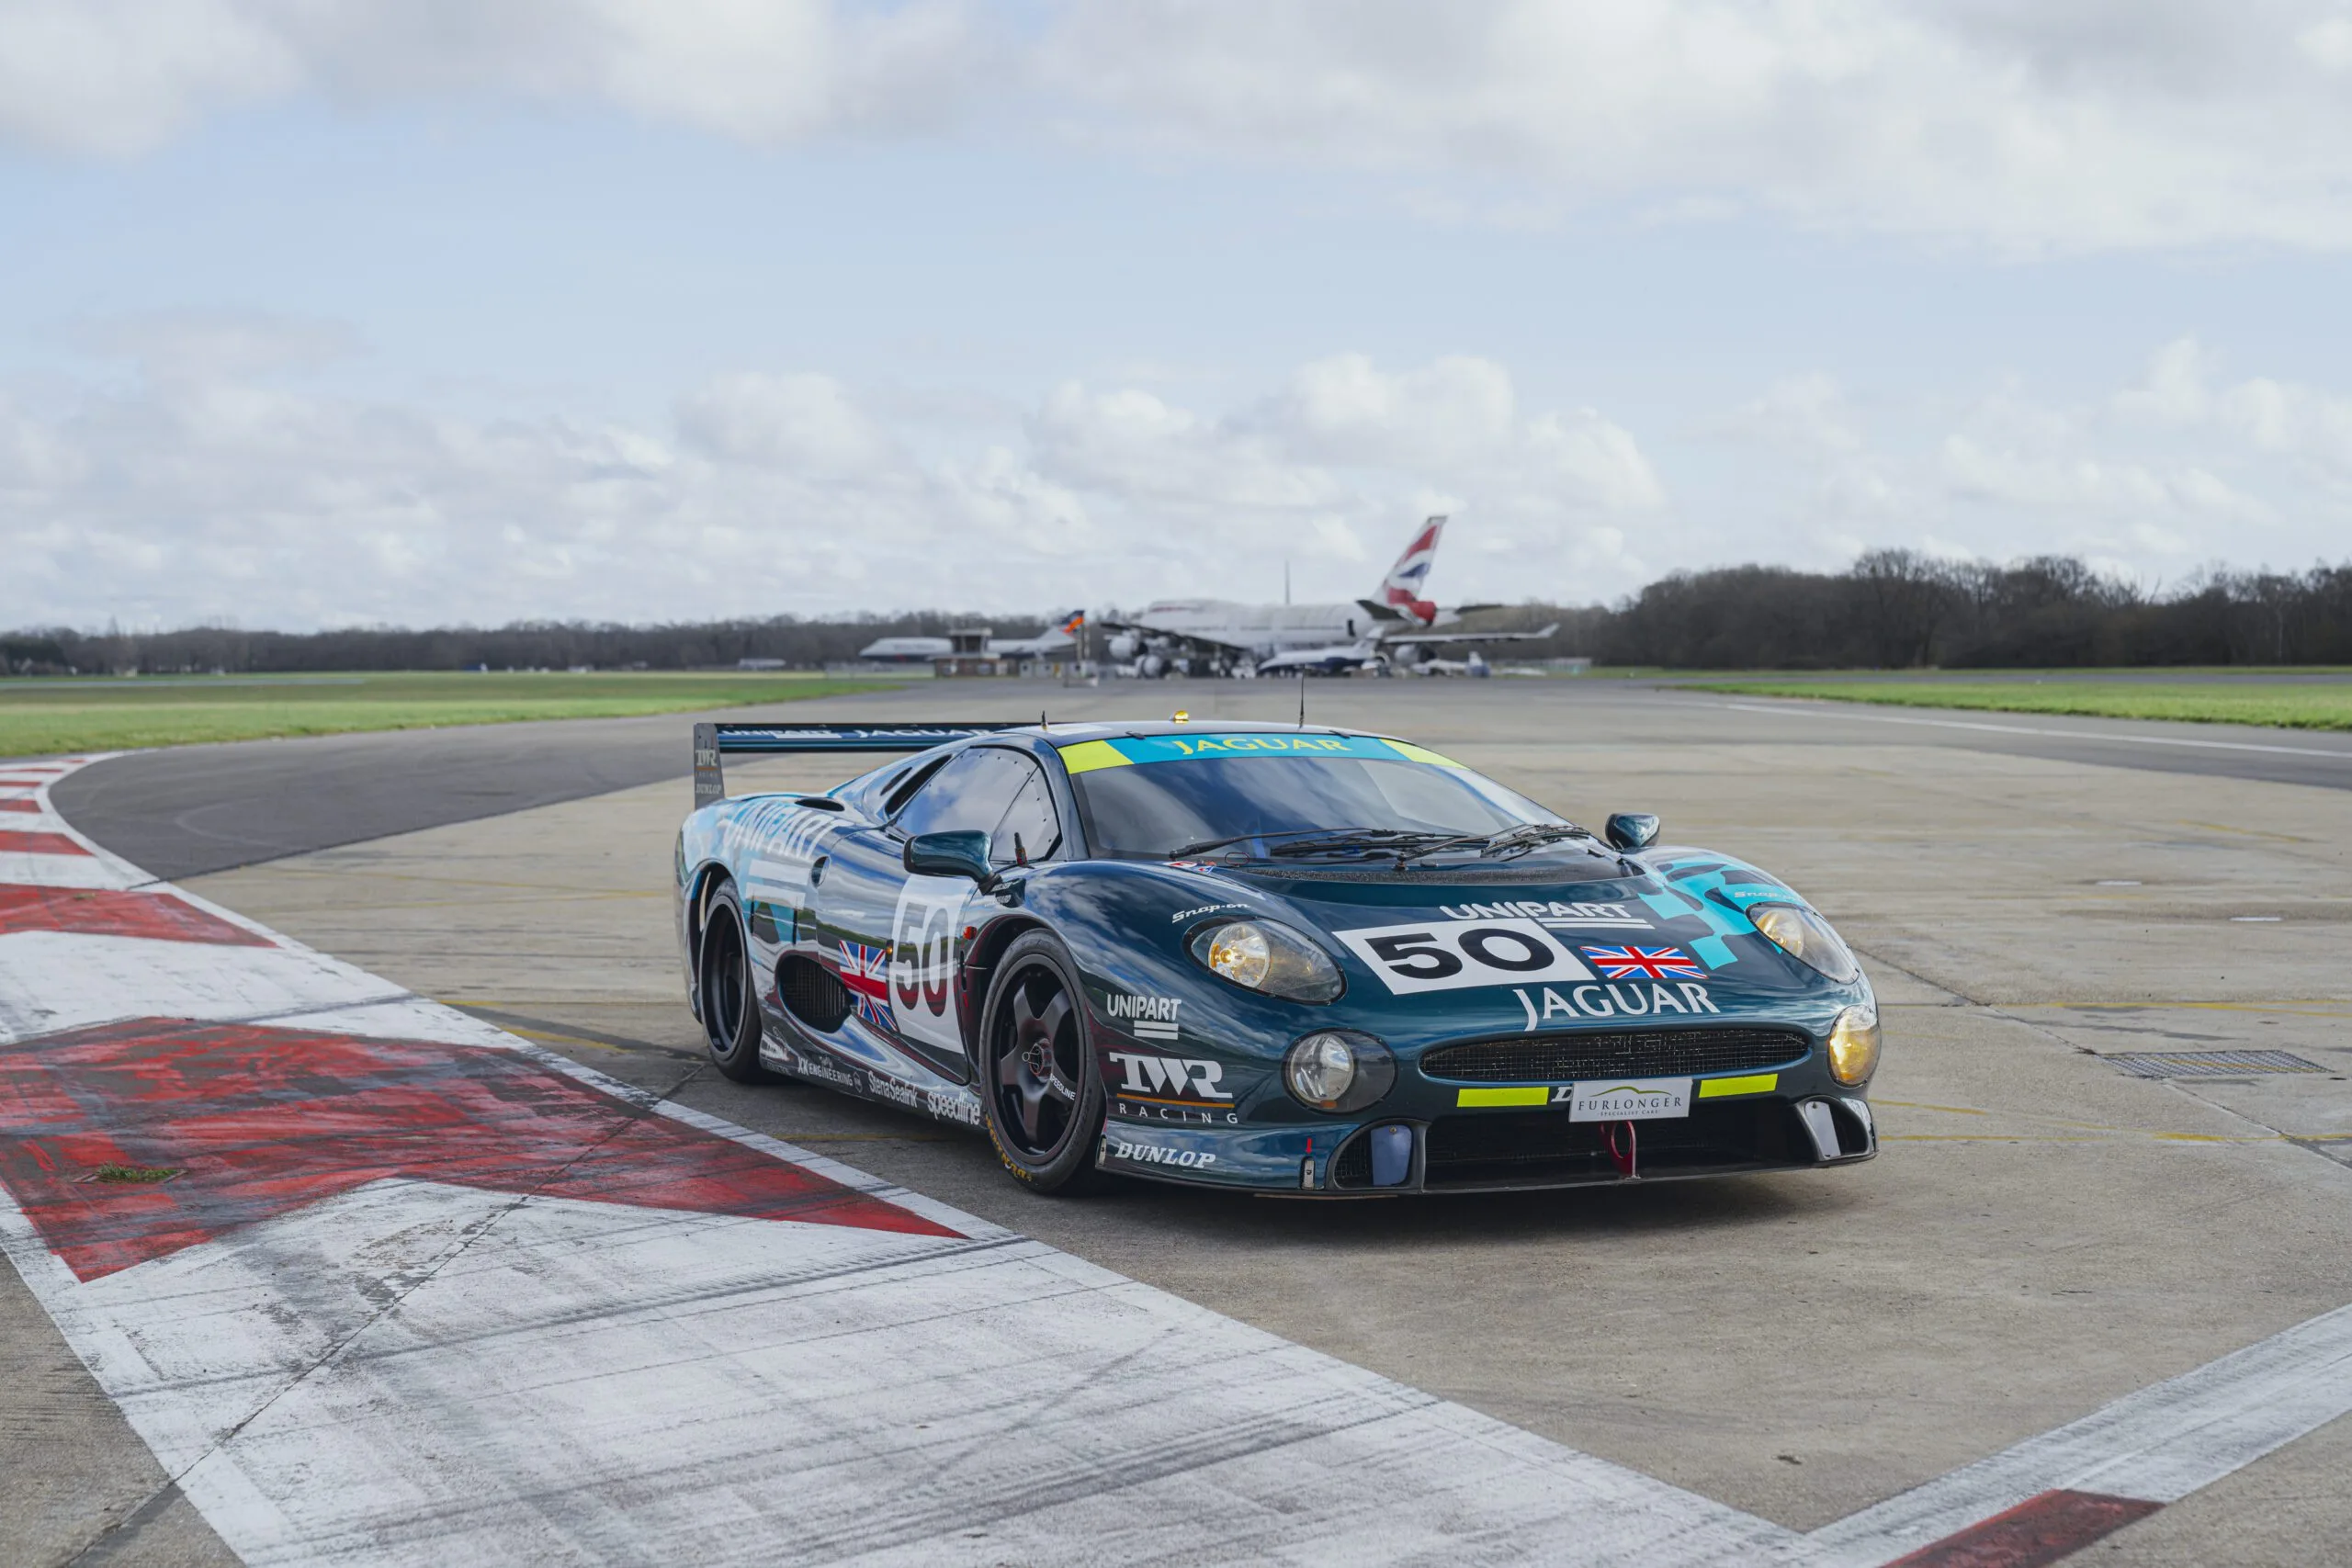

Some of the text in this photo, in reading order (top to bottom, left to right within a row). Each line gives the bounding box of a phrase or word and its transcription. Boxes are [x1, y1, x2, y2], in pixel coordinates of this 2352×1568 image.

[695, 750, 718, 766] TWR
[1172, 739, 1352, 755] JAGUAR
[1734, 890, 1795, 902] Snap-
[1171, 903, 1251, 925] Snap-on
[1439, 901, 1632, 920] UNIPART
[896, 902, 948, 1017] 50
[1364, 928, 1555, 980] 50
[1106, 994, 1182, 1021] UNIPART
[1512, 983, 1721, 1032] JAGUAR
[808, 1063, 854, 1088] ENGINEERING
[1109, 1052, 1234, 1099] TWR
[927, 1090, 981, 1126] speedline
[1119, 1102, 1238, 1125] RACING
[1577, 1097, 1682, 1111] FURLONGER
[1114, 1142, 1216, 1170] DUNLOP
